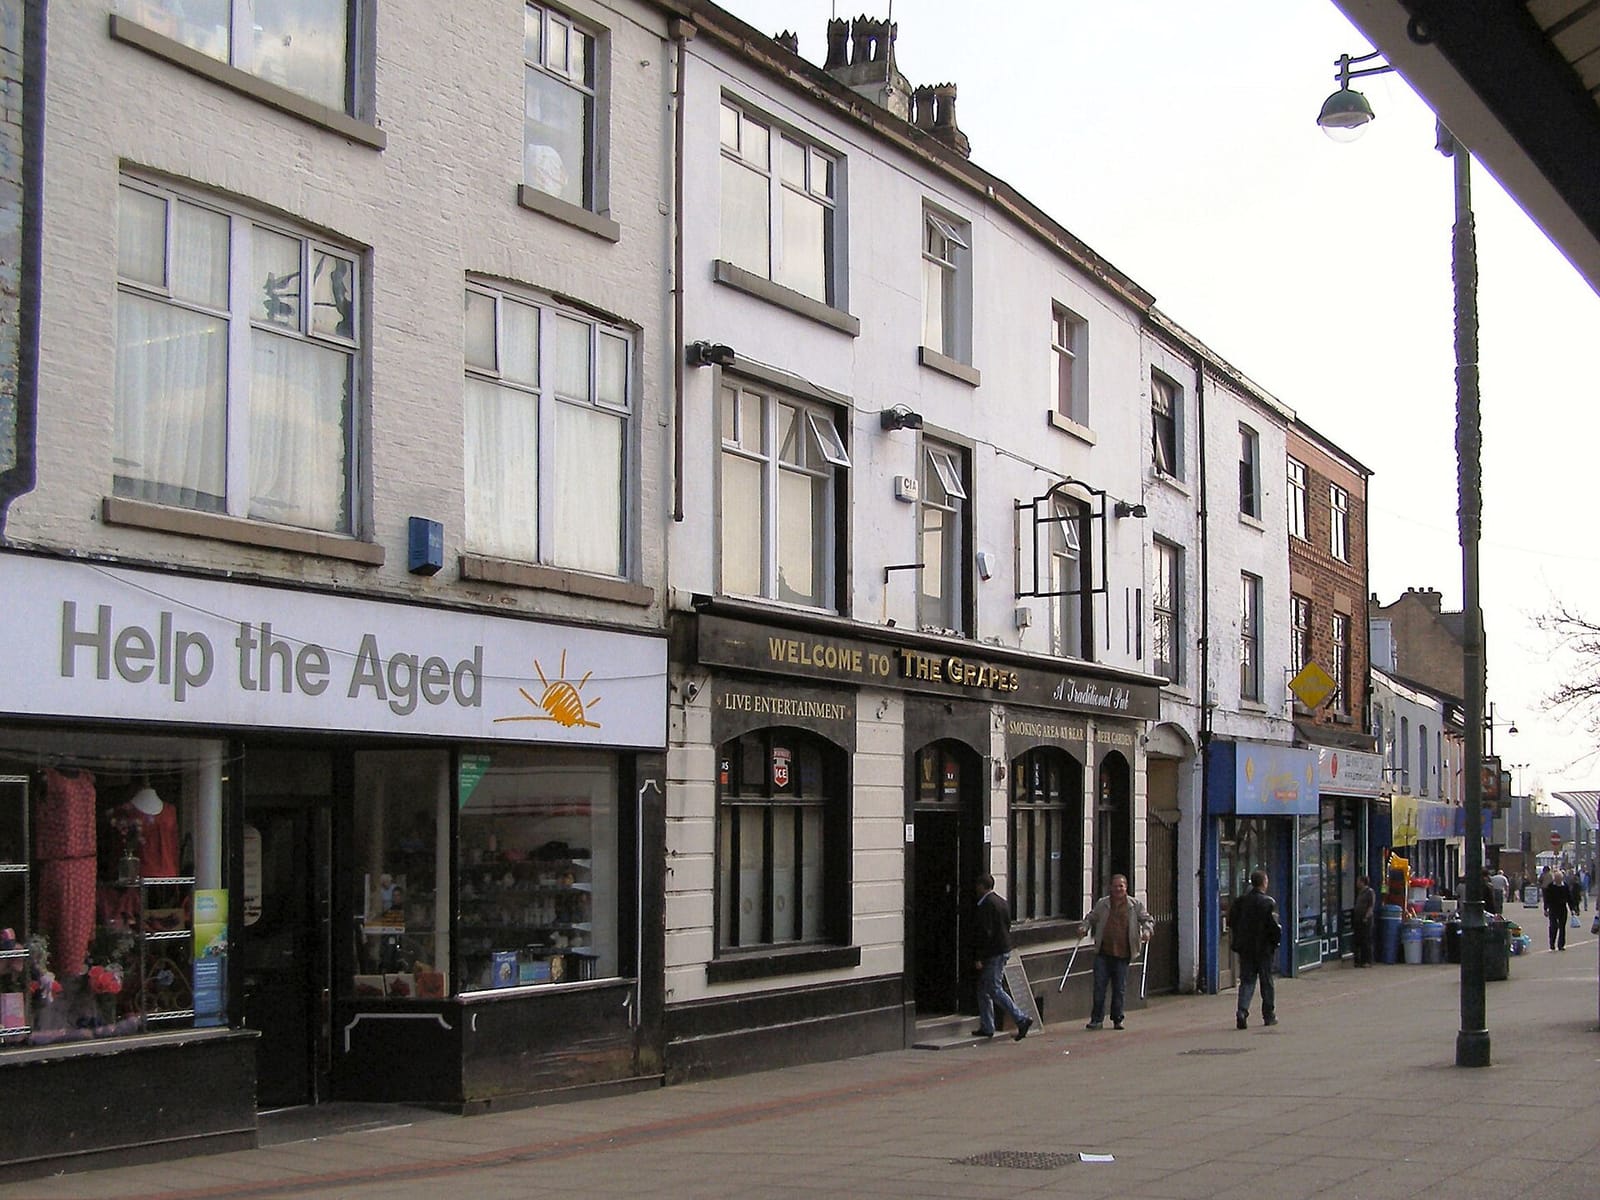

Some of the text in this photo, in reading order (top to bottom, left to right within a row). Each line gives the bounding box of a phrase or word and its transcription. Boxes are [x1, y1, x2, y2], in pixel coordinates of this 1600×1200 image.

[904, 479, 916, 490] CIA
[61, 601, 484, 715] Help the Aged
[768, 637, 1020, 692] WELCOME TO THE GRAPES
[1053, 678, 1130, 709] A Traditional Pub
[725, 694, 845, 720] LIVE ENTERTAINMENT
[1009, 721, 1042, 737] SMOKING
[1042, 725, 1059, 738] AREA
[1068, 728, 1084, 740] REAR
[1097, 730, 1111, 743] BEER
[775, 768, 787, 779] ICE
